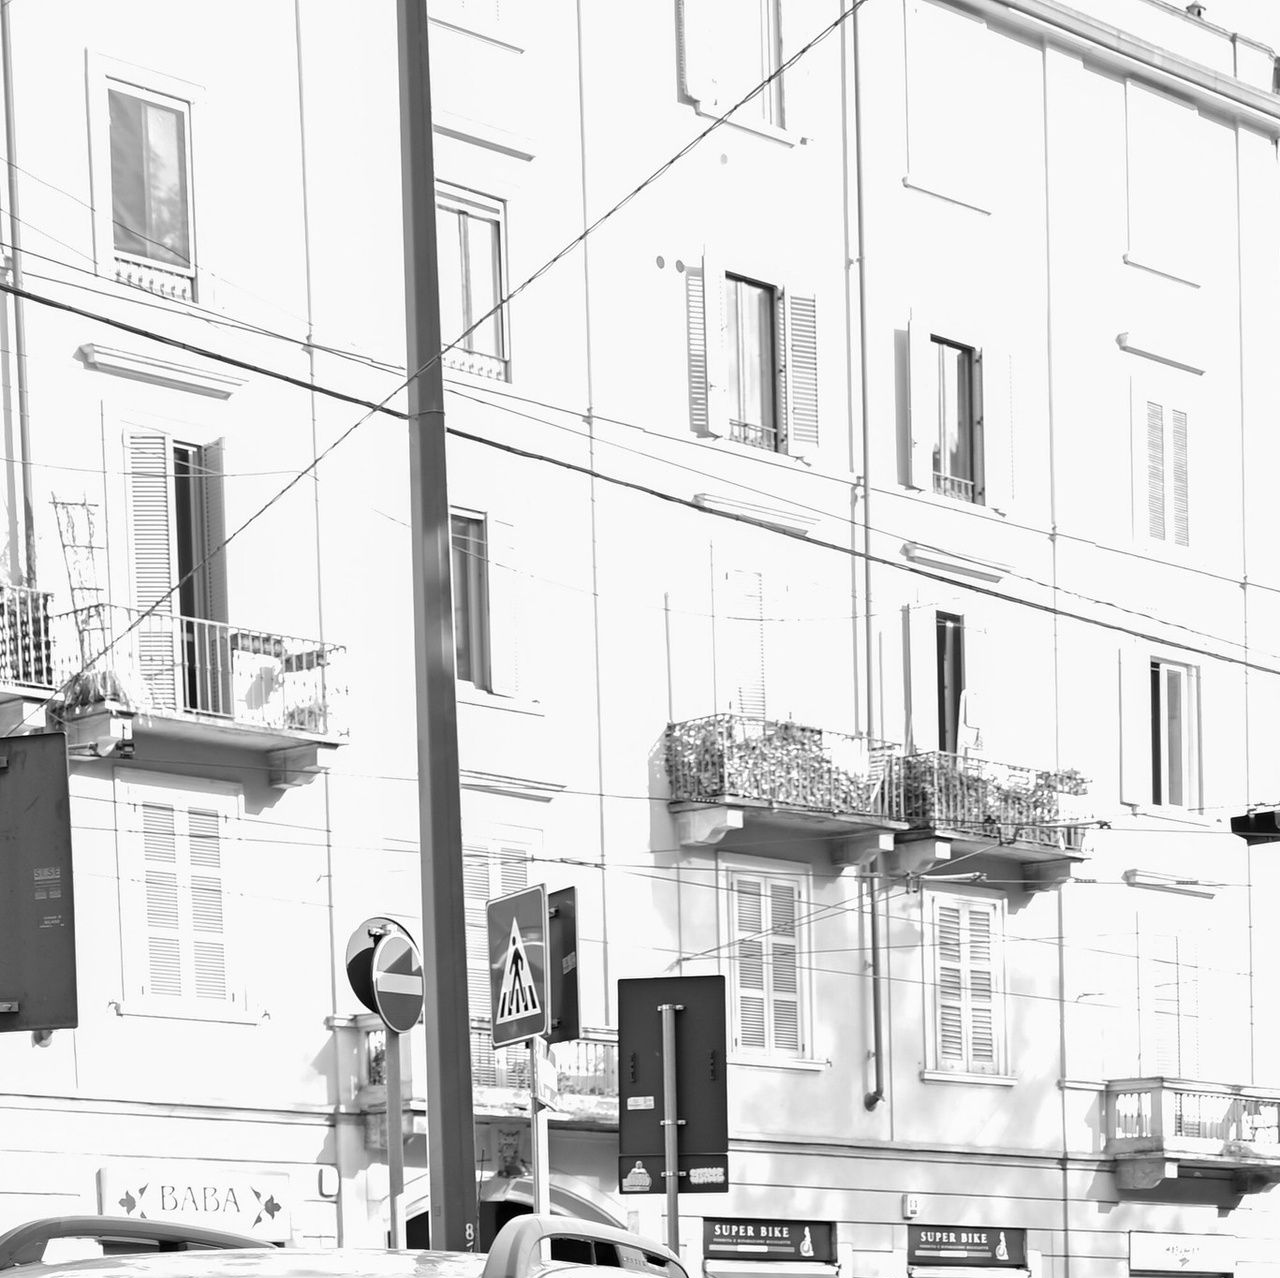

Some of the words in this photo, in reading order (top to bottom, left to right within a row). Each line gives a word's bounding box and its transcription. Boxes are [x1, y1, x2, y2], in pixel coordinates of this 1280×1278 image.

[161, 1185, 240, 1212] BABA
[714, 1224, 755, 1237] SUPER
[760, 1226, 790, 1238] BIKE
[920, 1231, 956, 1243] SUPER
[961, 1232, 988, 1244] BIKE
